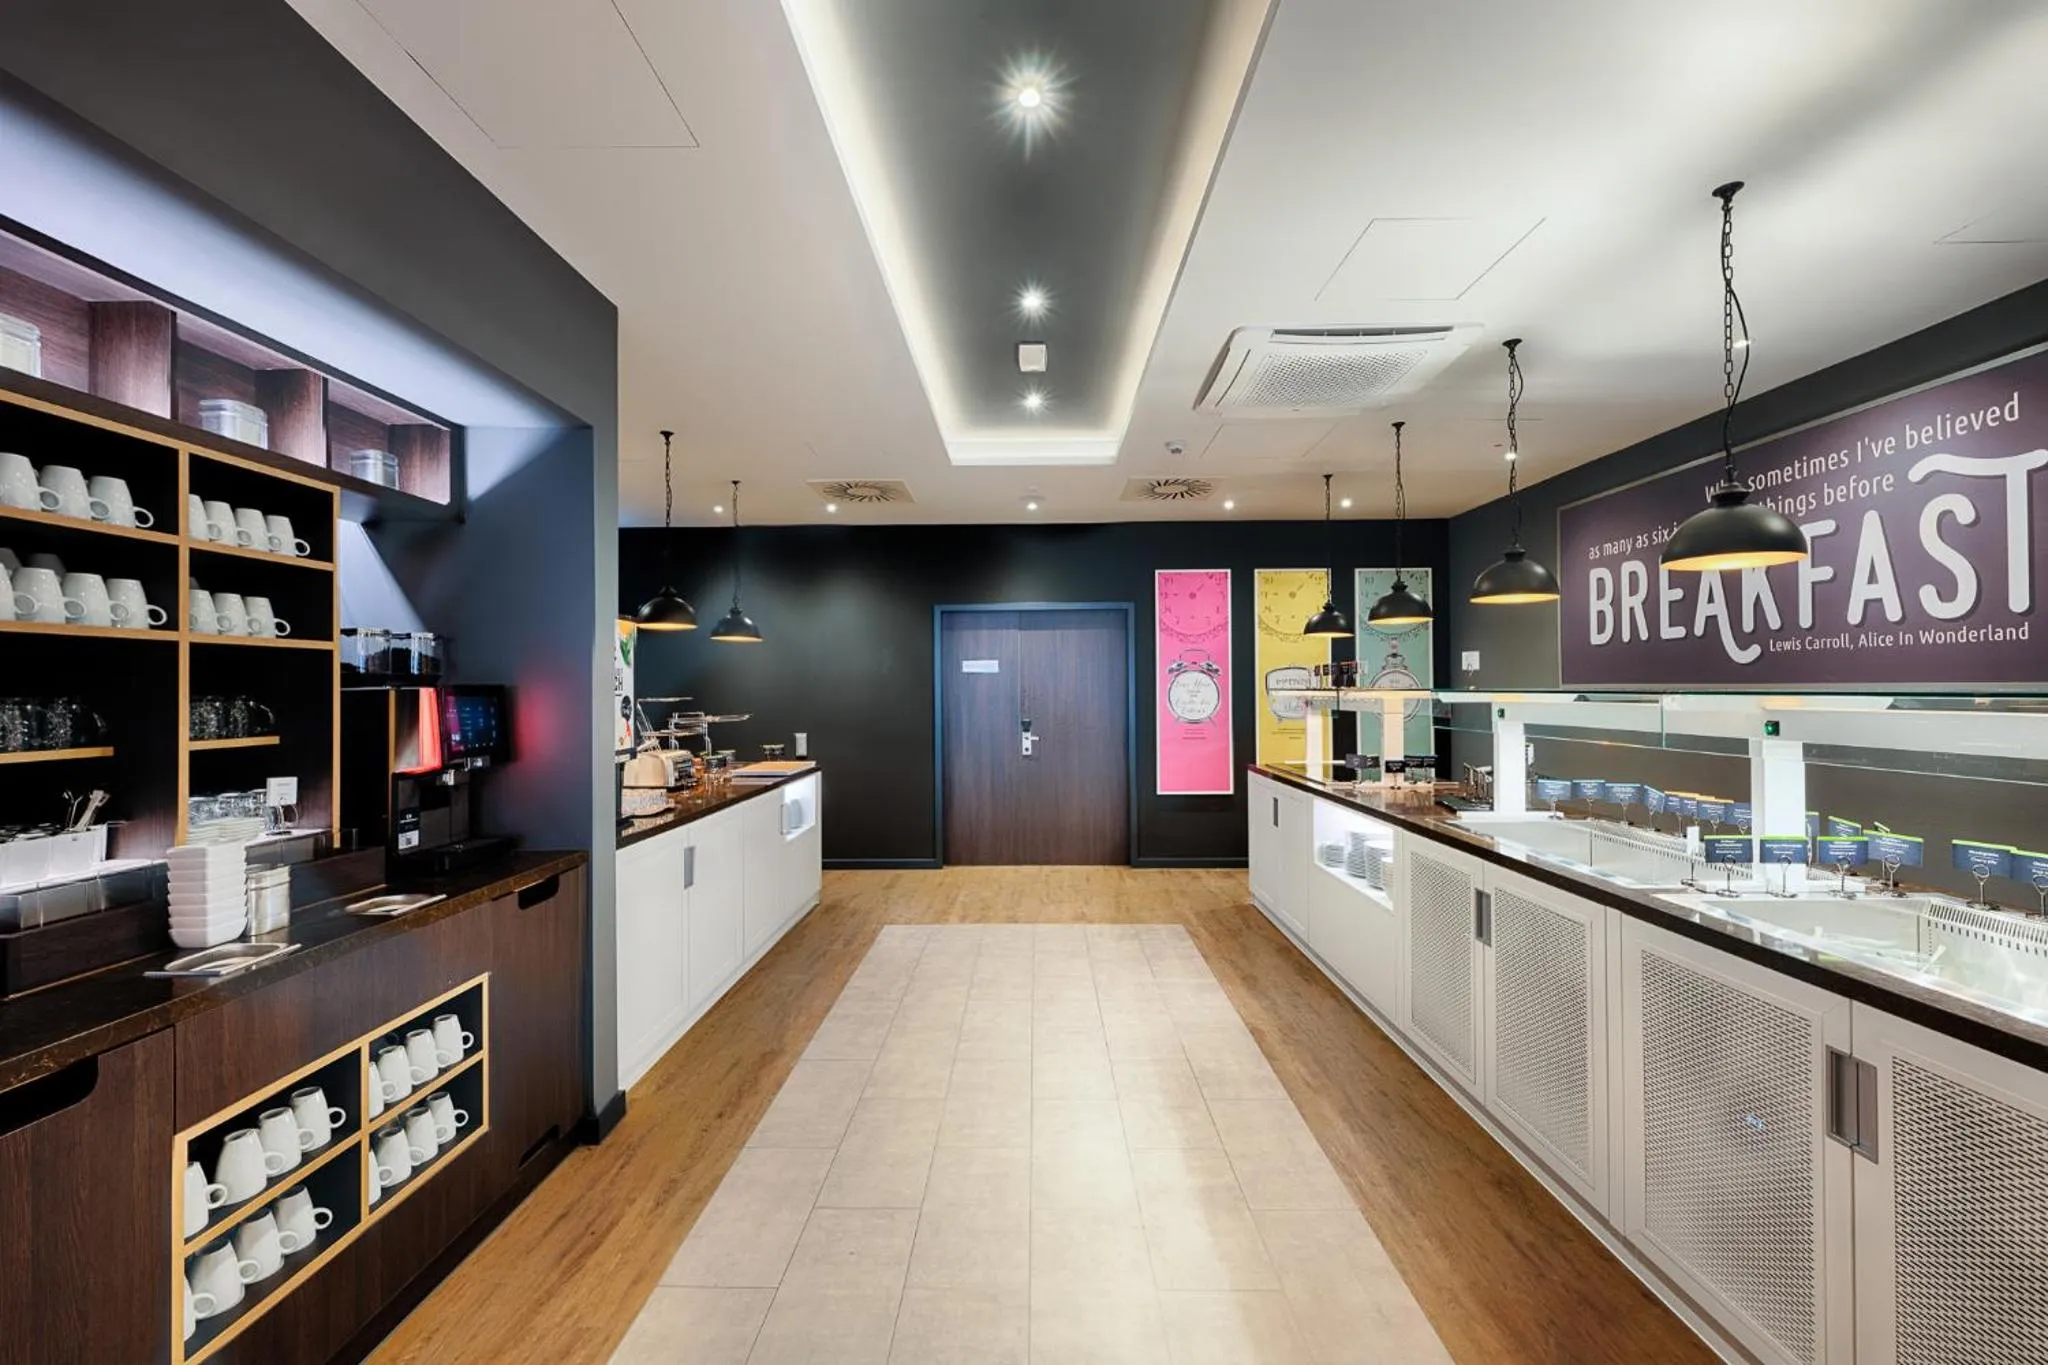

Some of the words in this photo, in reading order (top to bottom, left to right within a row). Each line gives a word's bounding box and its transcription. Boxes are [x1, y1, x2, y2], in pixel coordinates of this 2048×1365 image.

[1747, 450, 1849, 492] sometimes
[1856, 434, 1896, 464] I've
[1905, 391, 2020, 449] believed
[1588, 545, 1600, 560] as
[1603, 537, 1632, 555] many
[1636, 533, 1648, 549] as
[1652, 525, 1669, 545] six
[1759, 491, 1816, 517] hings
[1823, 473, 1895, 506] before
[1588, 449, 2048, 664] BREAKFAST
[1769, 636, 1802, 652] Lewis
[1805, 633, 1854, 651] Carroll,
[1858, 632, 1894, 648] Alice
[1899, 632, 1914, 646] In
[1919, 622, 2030, 645] Wonderland
